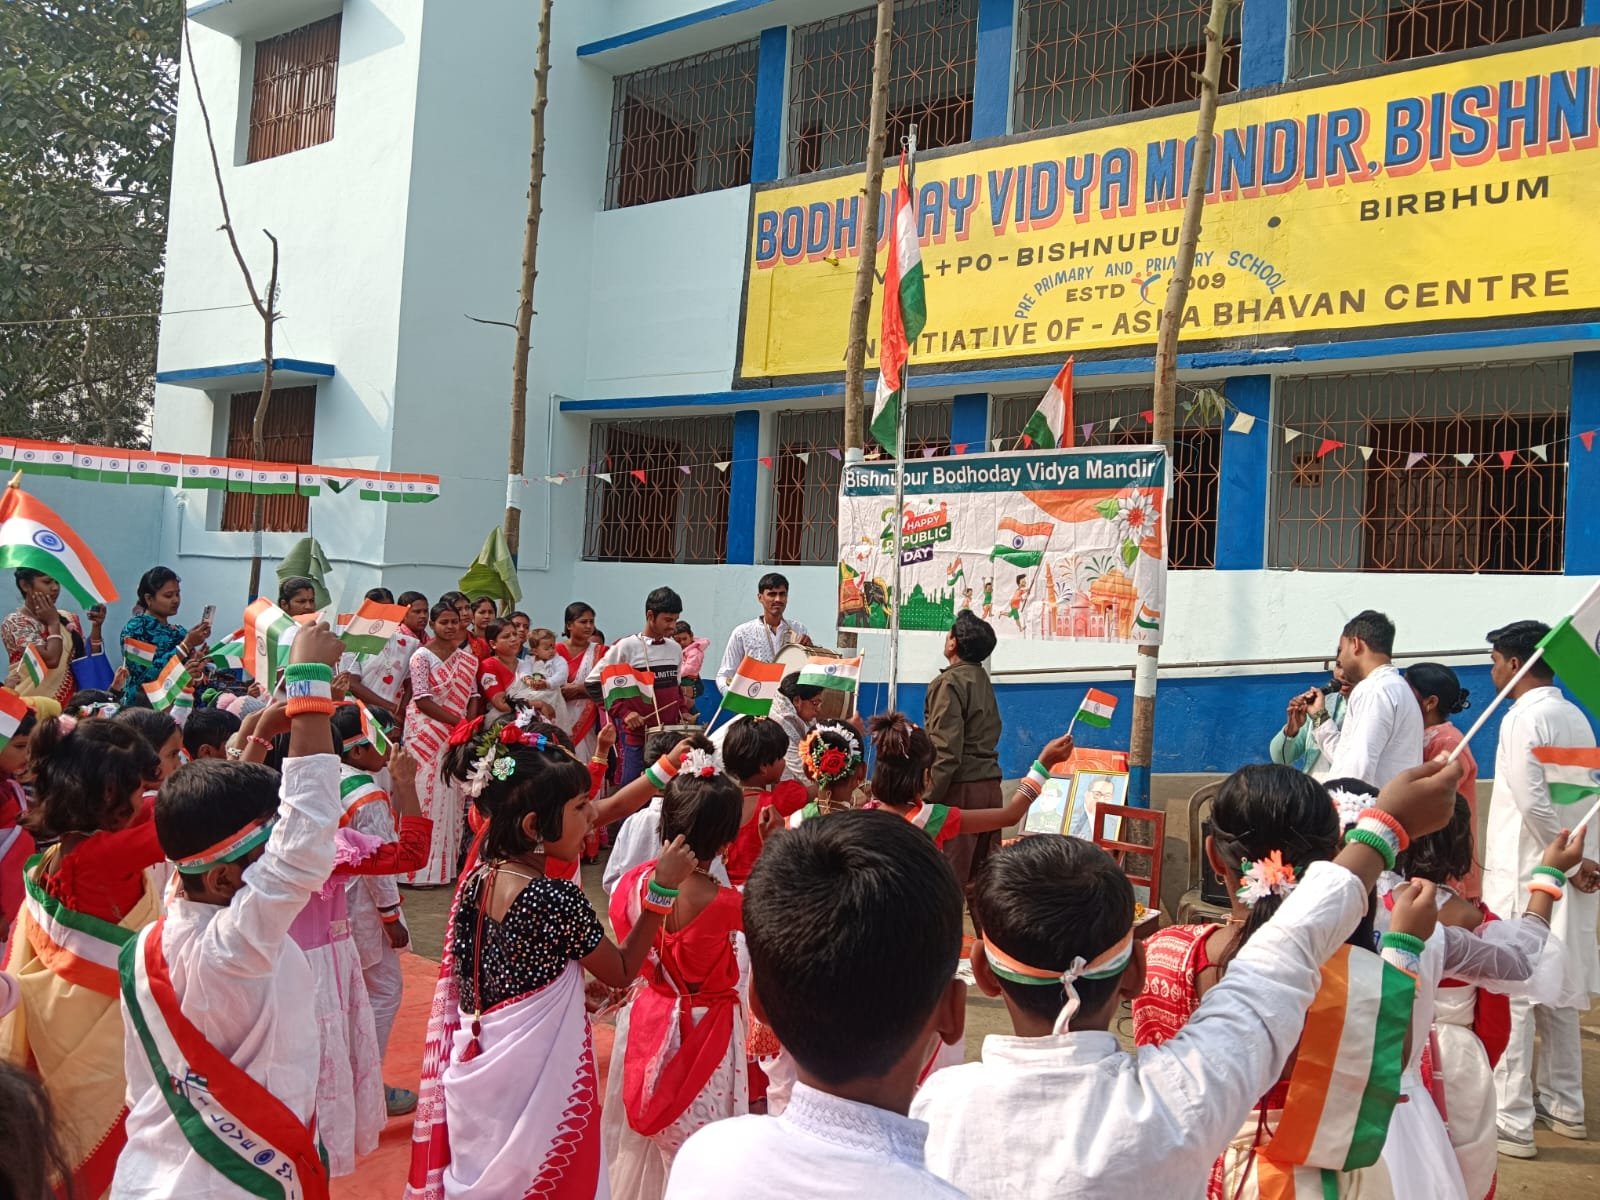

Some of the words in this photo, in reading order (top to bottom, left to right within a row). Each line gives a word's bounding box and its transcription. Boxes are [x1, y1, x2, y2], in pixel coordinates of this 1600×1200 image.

[755, 172, 981, 270] BODHAY
[987, 147, 1138, 236] VIDYA
[1384, 65, 1600, 178] BISHN
[1359, 175, 1549, 222] BIRBHUM
[1014, 293, 1036, 320] PRE
[1034, 265, 1095, 297] PRIMARY
[1104, 260, 1134, 278] AND
[1146, 250, 1214, 272] PRIRY
[1227, 250, 1287, 295] SCHOOL
[1065, 283, 1126, 303] ESTD
[1166, 272, 1226, 293] 009
[911, 321, 1037, 356] ITIATIVE
[1112, 305, 1200, 337] ASA
[1213, 288, 1366, 327] BHAVAN
[1385, 268, 1570, 311] CENTRE
[933, 463, 1021, 487] Bodhoday
[1026, 461, 1079, 485] Vidya
[1086, 458, 1156, 480] Mandir
[885, 526, 949, 550] RPUBLIC
[906, 515, 941, 530] HAPPY
[904, 547, 930, 563] DAY
[210, 1113, 257, 1151] LOVE
